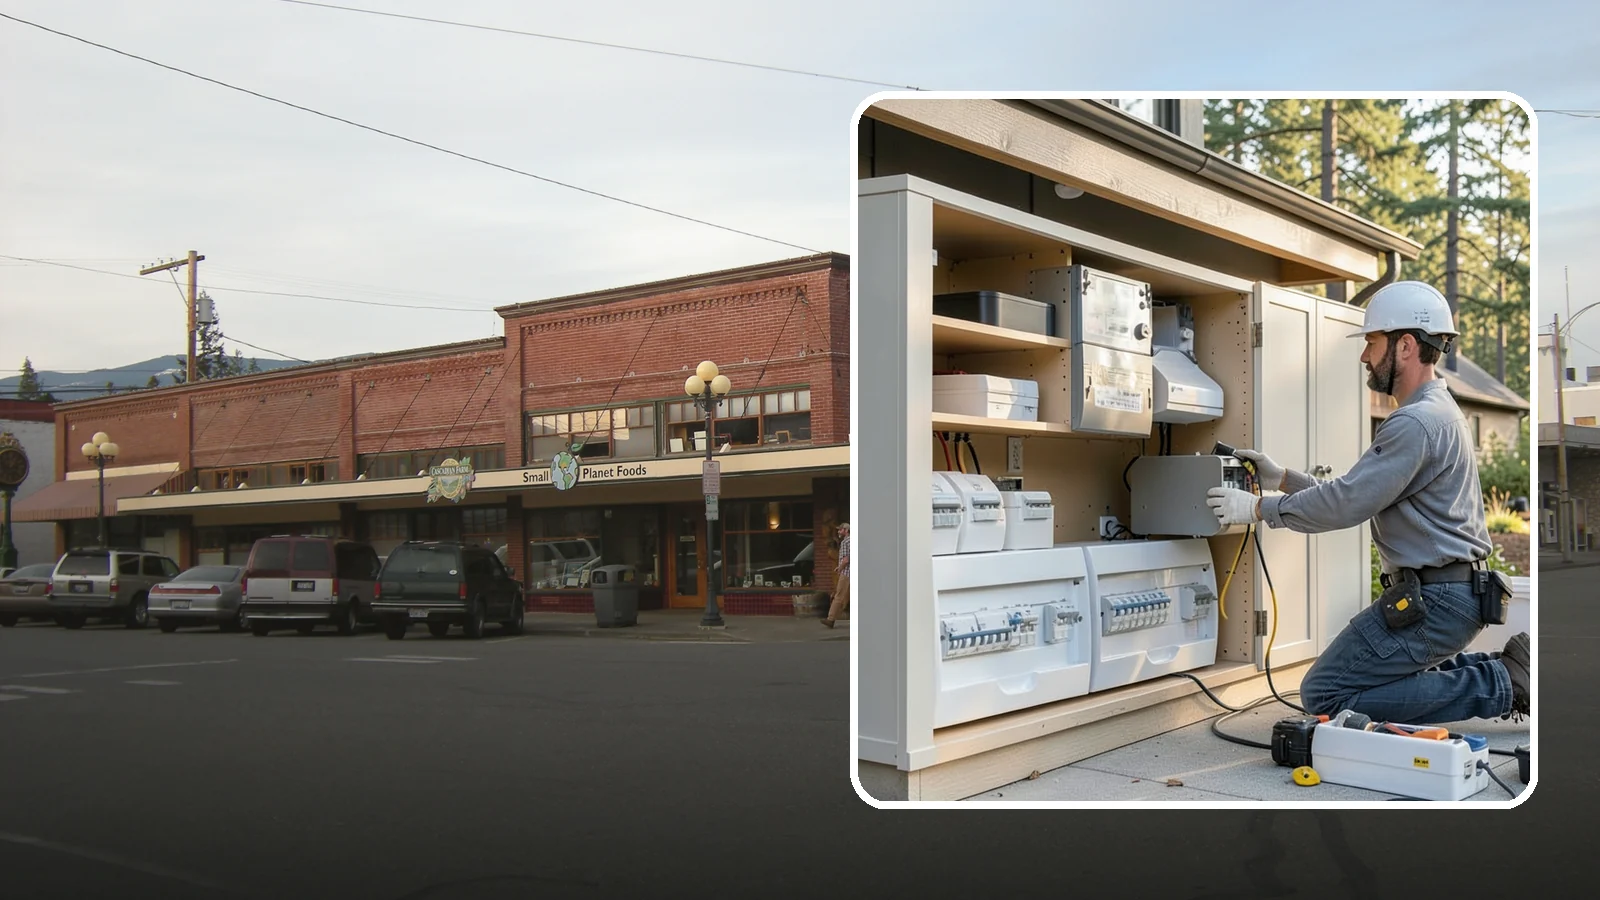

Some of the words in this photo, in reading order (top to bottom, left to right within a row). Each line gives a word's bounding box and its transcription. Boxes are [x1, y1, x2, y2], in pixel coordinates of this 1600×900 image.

[523, 471, 549, 483] Small
[582, 468, 614, 479] Planet
[617, 464, 647, 477] Foods
